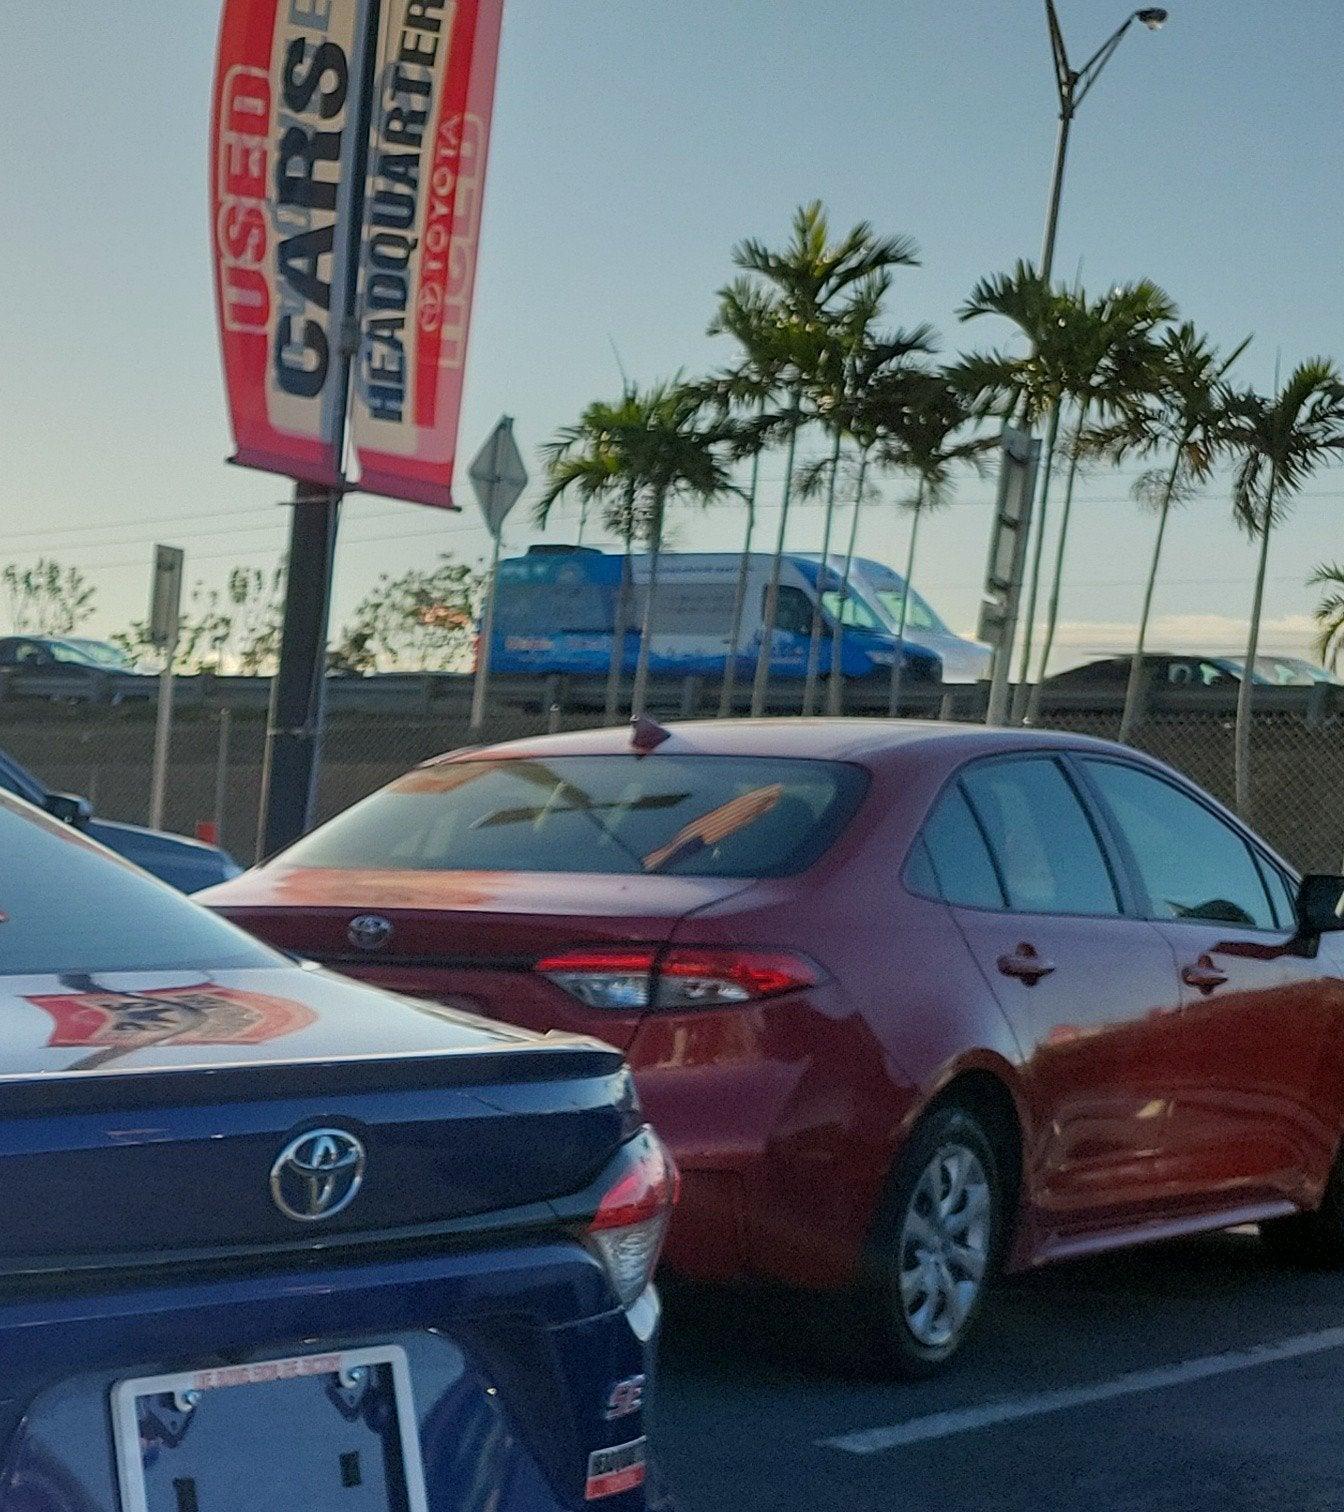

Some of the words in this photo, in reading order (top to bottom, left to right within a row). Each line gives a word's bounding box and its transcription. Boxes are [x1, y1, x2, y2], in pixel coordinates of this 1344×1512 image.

[219, 64, 271, 334] USED
[275, 36, 348, 398] CARS
[425, 114, 462, 272] TOYOTA
